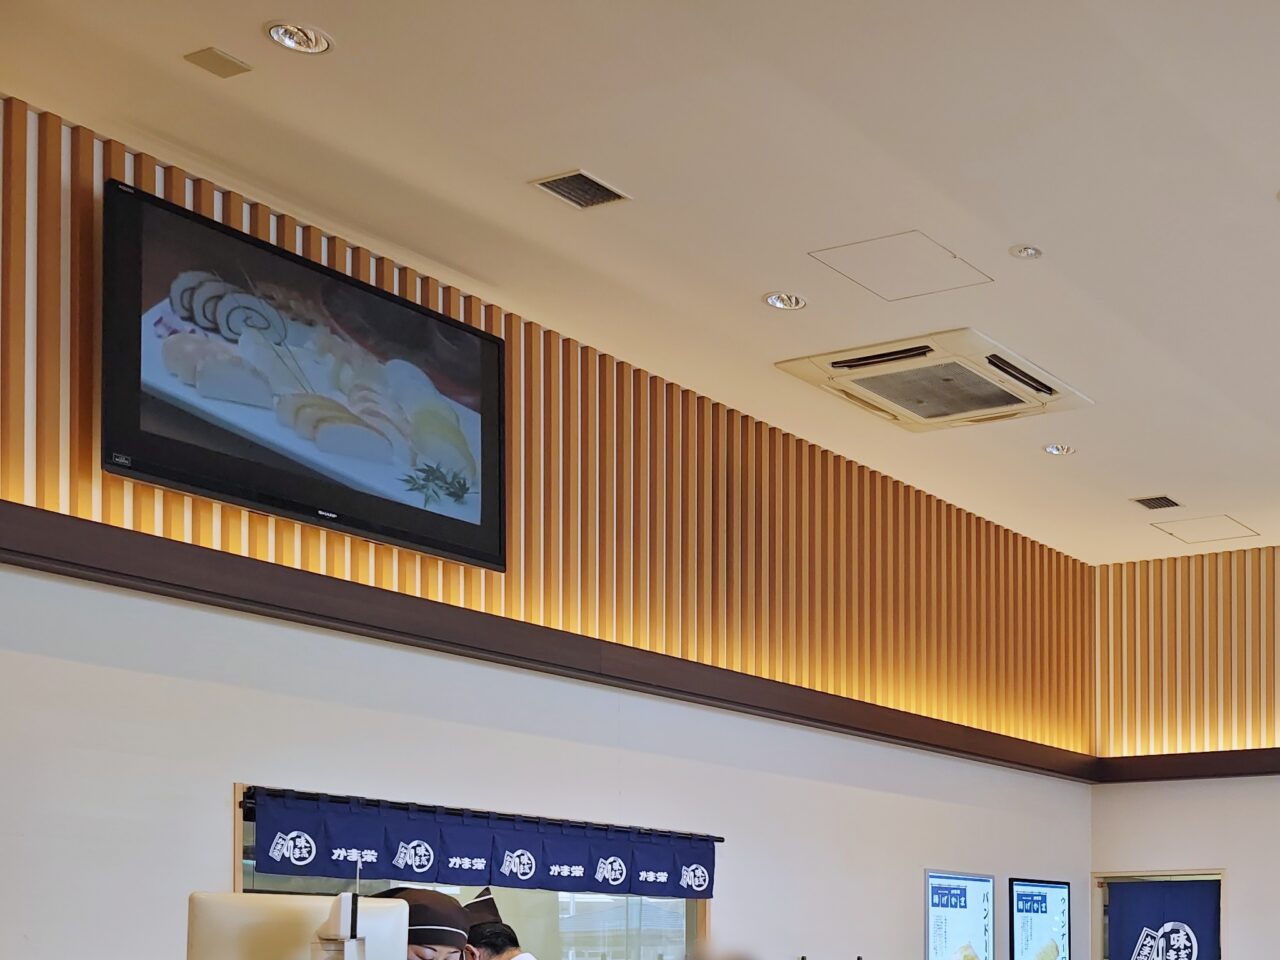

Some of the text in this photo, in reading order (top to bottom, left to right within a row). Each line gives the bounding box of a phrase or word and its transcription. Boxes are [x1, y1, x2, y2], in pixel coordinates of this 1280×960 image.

[332, 848, 378, 863] かま栄
[448, 857, 487, 870] かま栄
[550, 864, 584, 877] かま栄
[639, 871, 668, 883] かま栄
